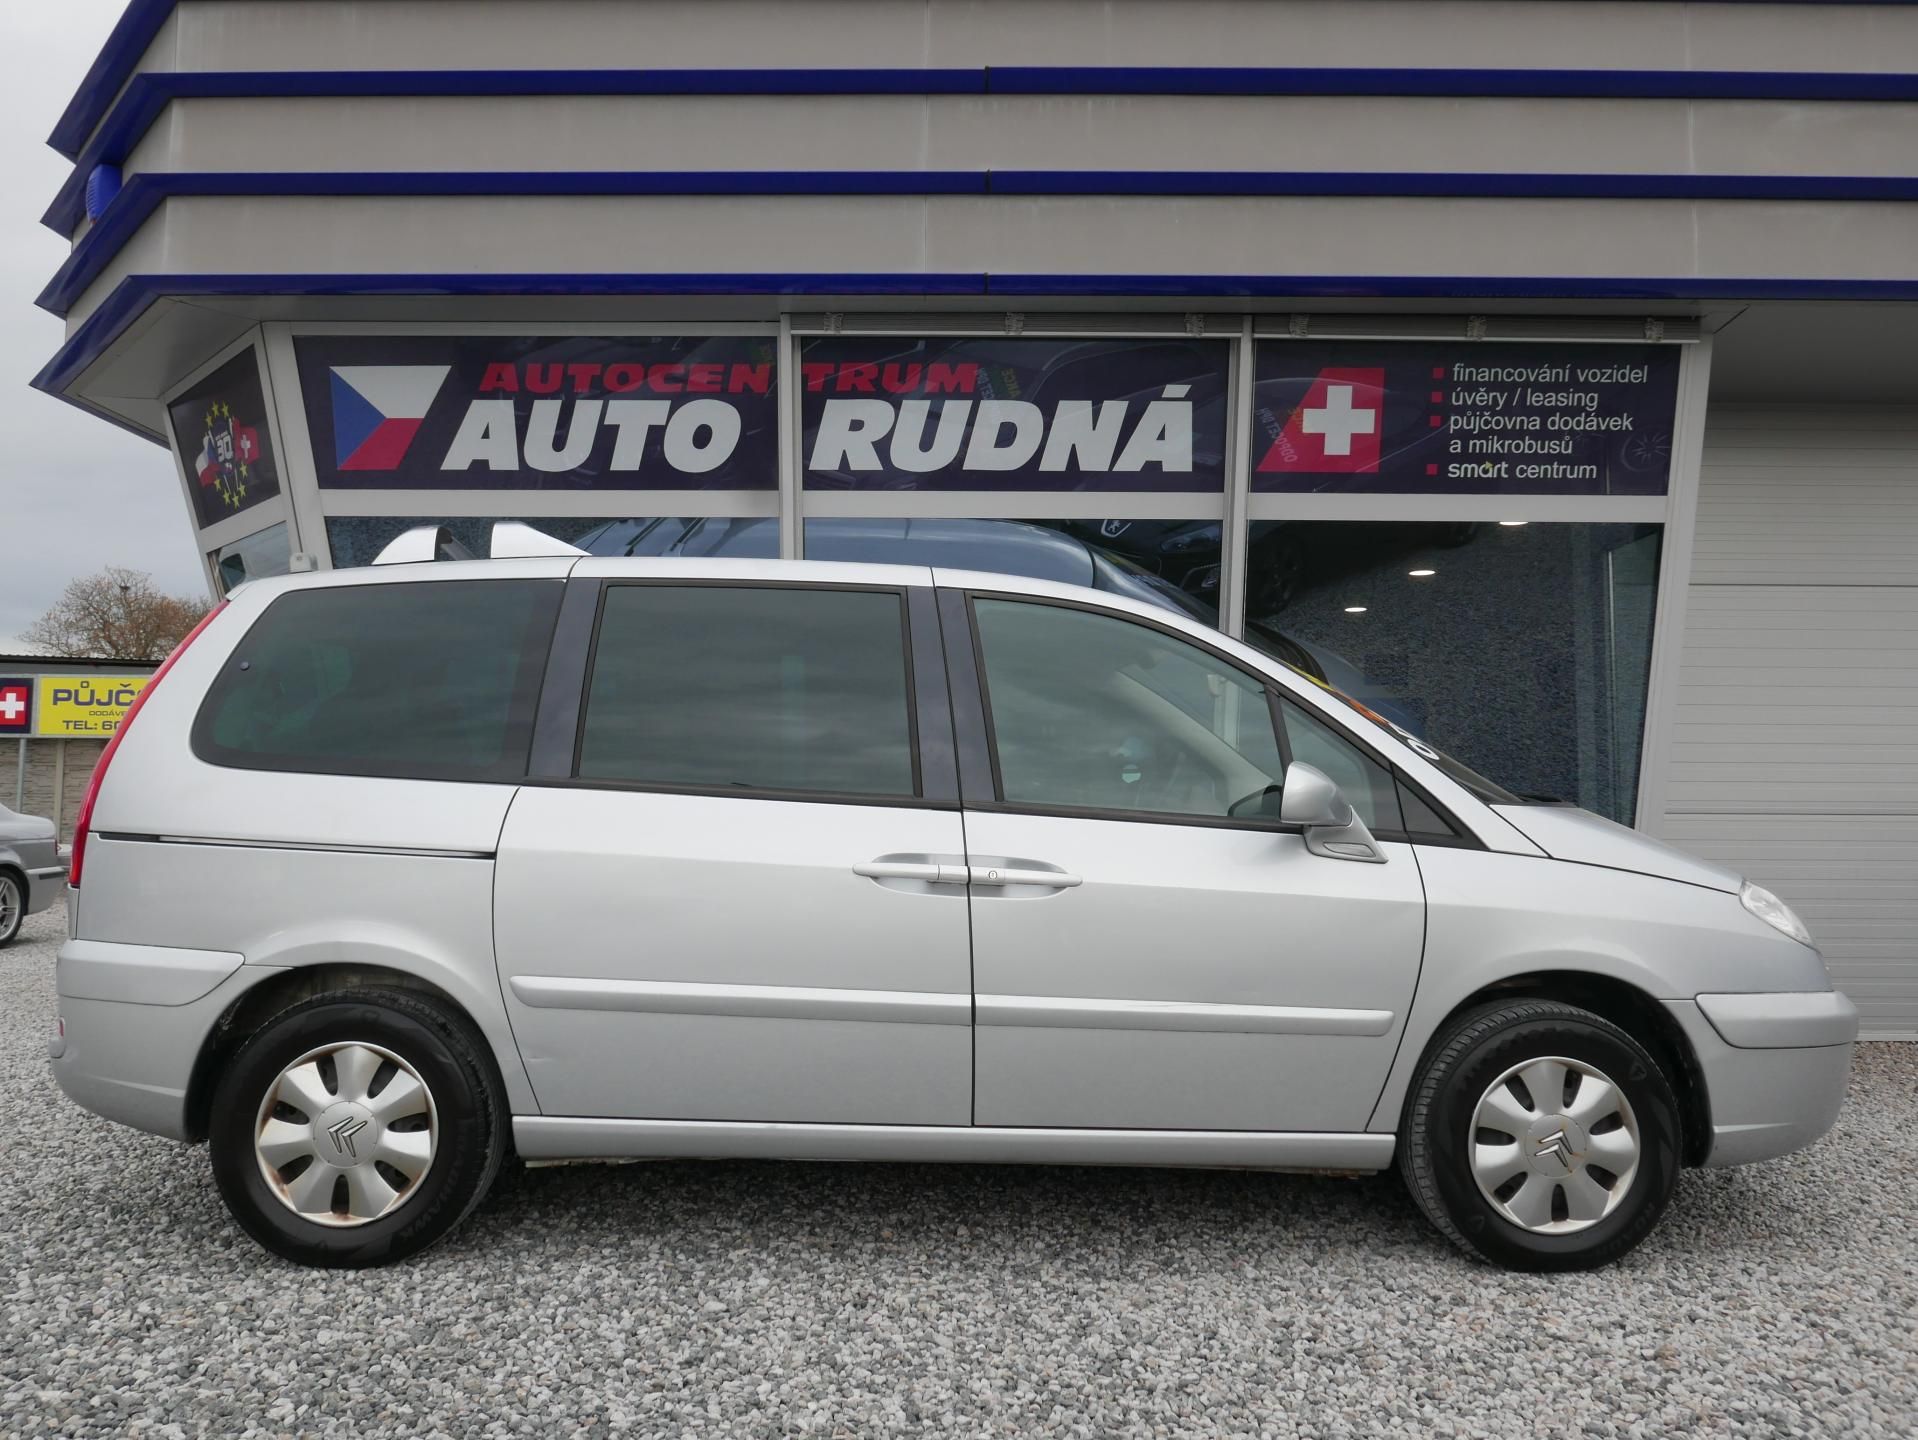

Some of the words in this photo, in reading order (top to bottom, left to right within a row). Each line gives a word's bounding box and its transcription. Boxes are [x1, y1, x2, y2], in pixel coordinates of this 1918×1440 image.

[1453, 363, 1571, 383] financování
[1577, 364, 1649, 383] vozidel
[1451, 387, 1507, 410] úvěry
[1512, 387, 1521, 407] /
[1526, 388, 1599, 411] leasing
[440, 398, 742, 473] AUTO
[808, 384, 1193, 473] RUDNÁ
[1450, 410, 1540, 434] půjčovna
[1547, 412, 1634, 431] dodávek
[1450, 439, 1461, 454] a
[1468, 435, 1573, 454] mikrobusů
[1448, 461, 1508, 478] smart
[1515, 461, 1597, 479] centrum
[52, 681, 141, 707] PŮJČ
[62, 720, 98, 731] TEL:
